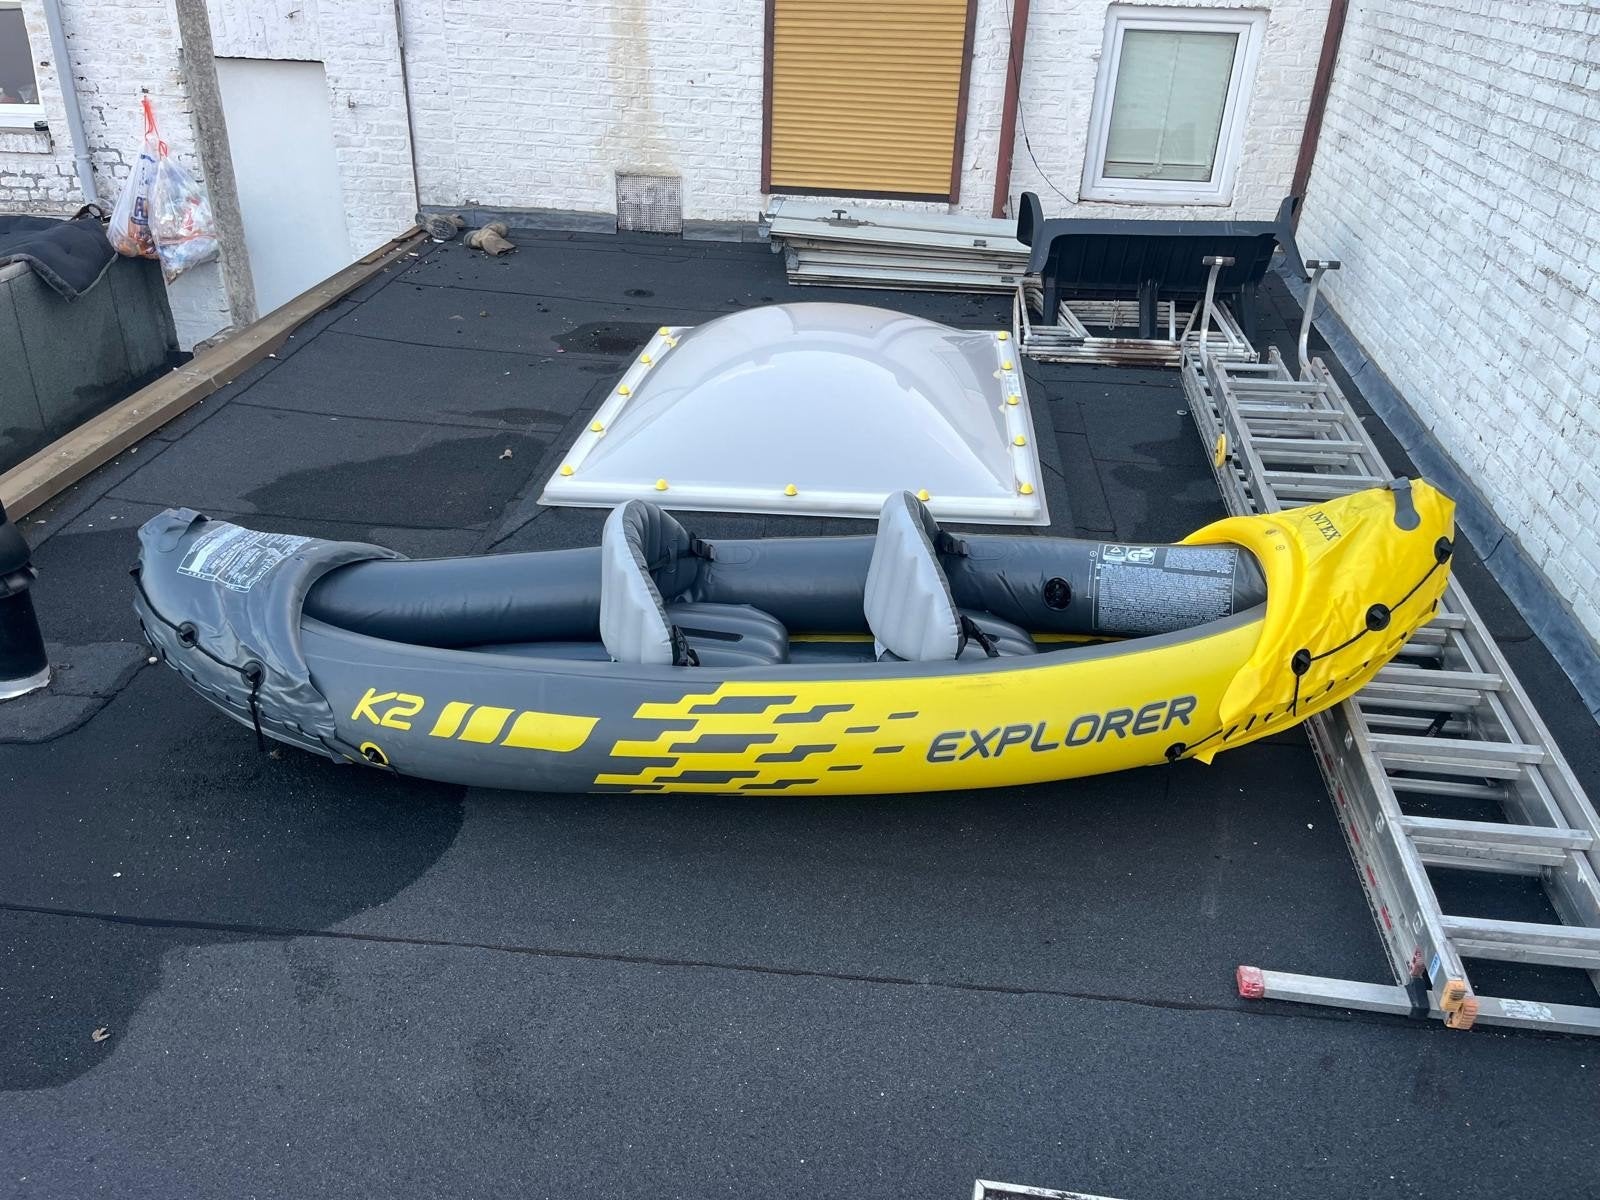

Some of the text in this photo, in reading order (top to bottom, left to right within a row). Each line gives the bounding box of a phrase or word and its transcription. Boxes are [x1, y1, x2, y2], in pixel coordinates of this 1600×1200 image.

[1307, 510, 1342, 541] INTEX
[351, 687, 425, 731] K2
[926, 695, 1197, 763] EXPLORER
